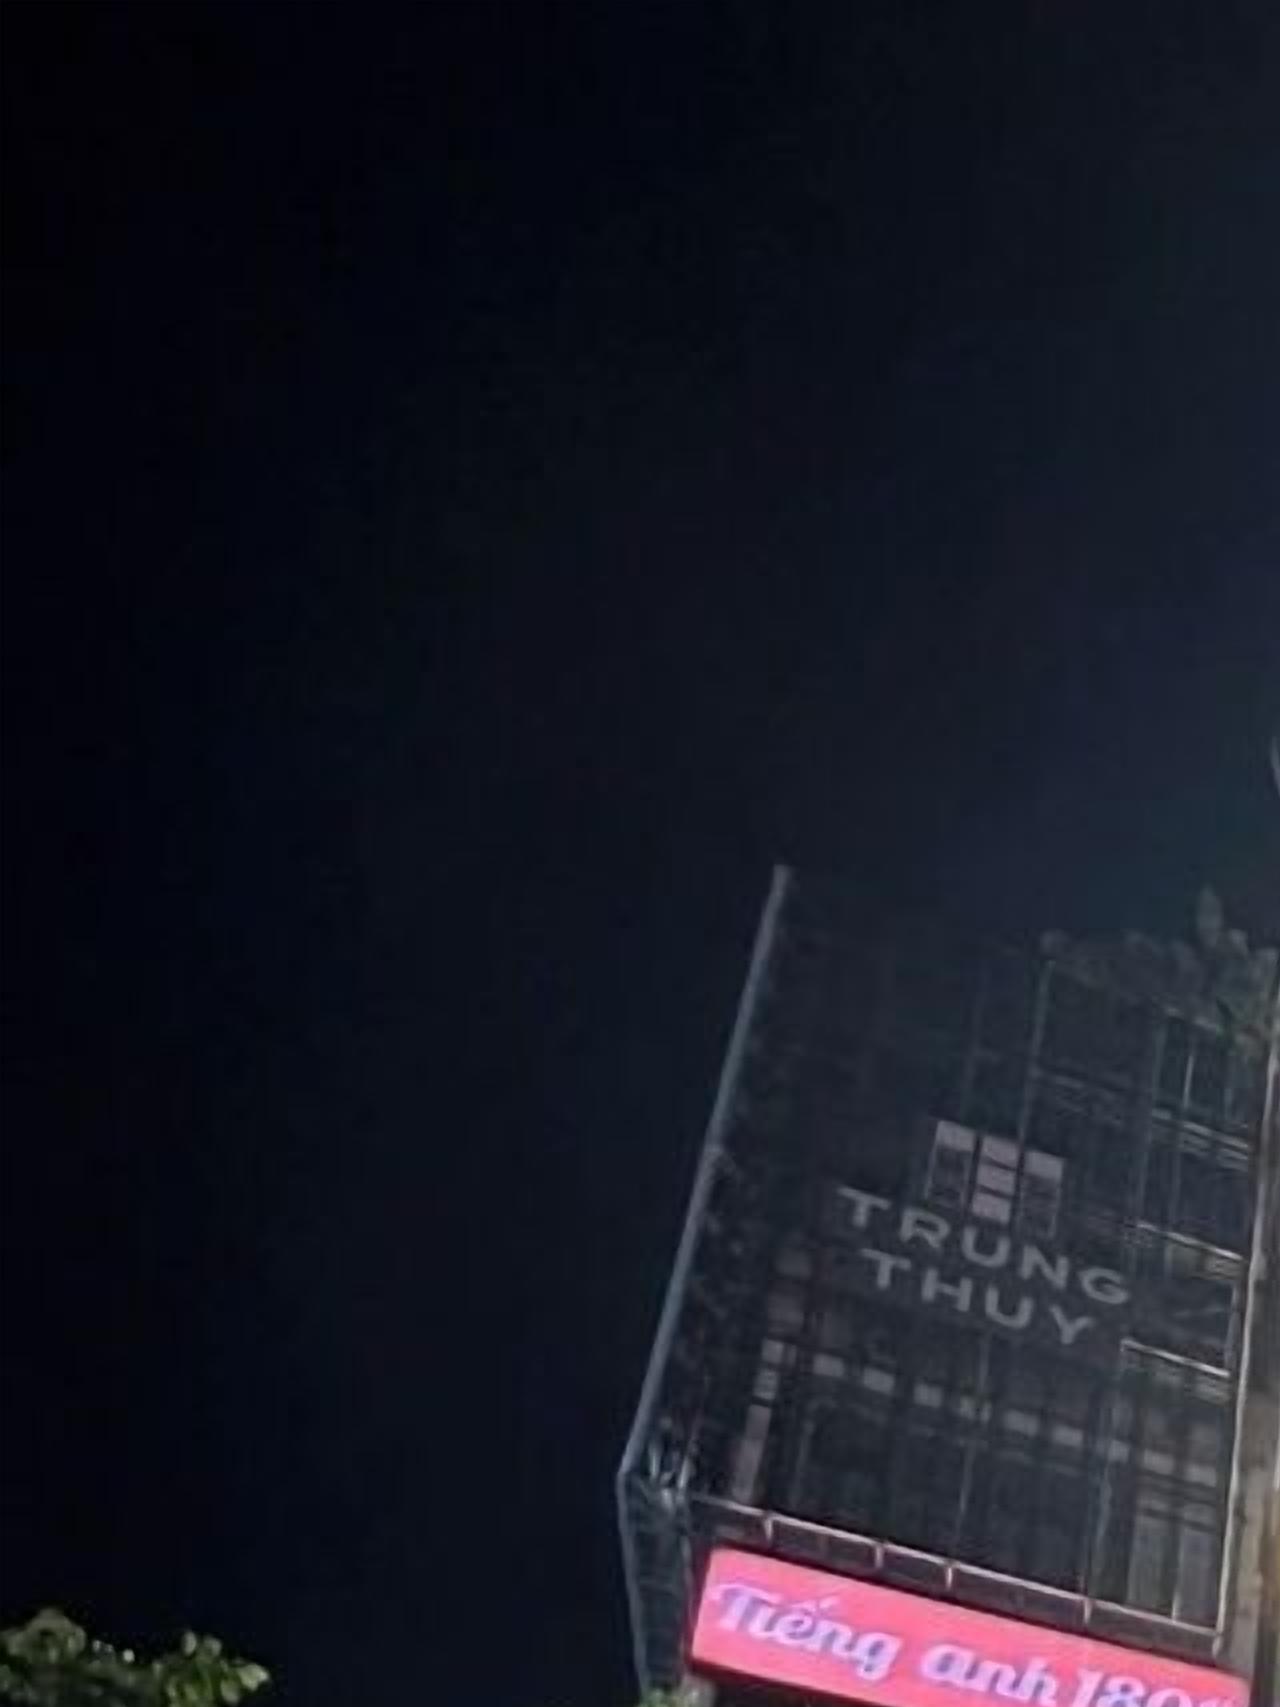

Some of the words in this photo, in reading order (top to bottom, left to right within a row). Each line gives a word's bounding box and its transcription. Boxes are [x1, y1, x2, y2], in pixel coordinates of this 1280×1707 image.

[836, 1185, 1130, 1305] TRUNG
[860, 1247, 1094, 1345] THUY
[712, 1582, 905, 1682] Tiếng
